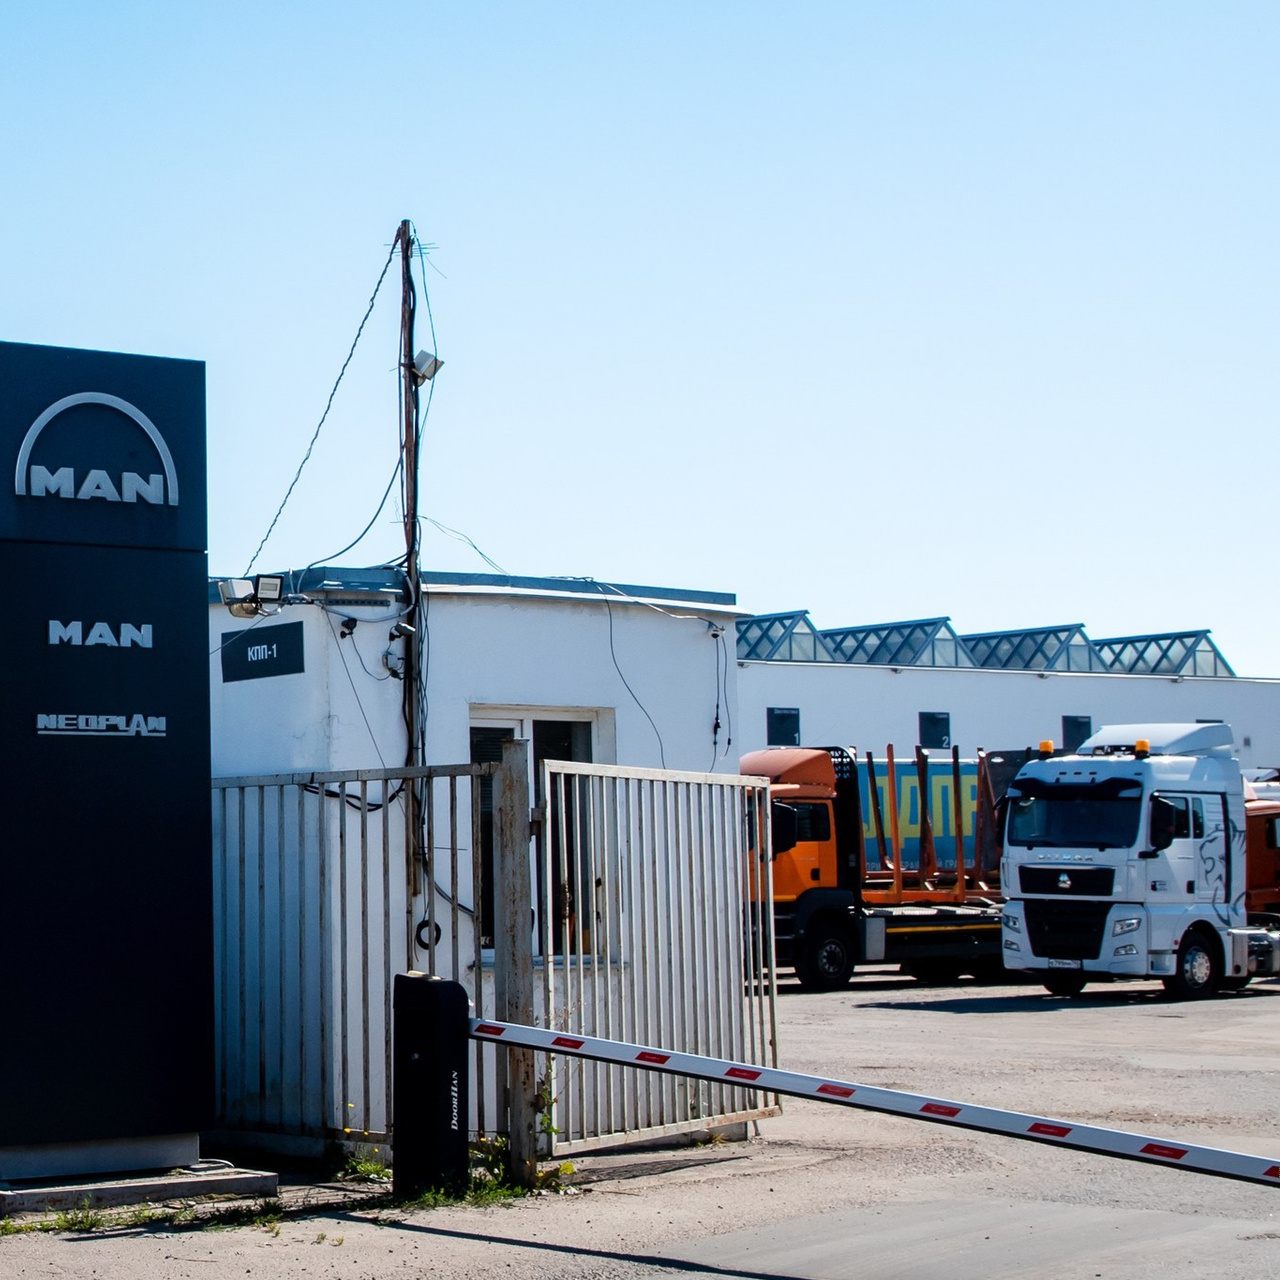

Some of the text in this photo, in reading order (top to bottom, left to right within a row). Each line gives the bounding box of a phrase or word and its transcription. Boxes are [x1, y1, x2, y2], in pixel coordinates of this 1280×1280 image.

[30, 465, 164, 505] MAN
[49, 620, 153, 648] MAN
[248, 644, 277, 662] КПП-1
[37, 714, 166, 736] NEOPLAN
[794, 732, 800, 744] 1
[942, 736, 950, 748] 2
